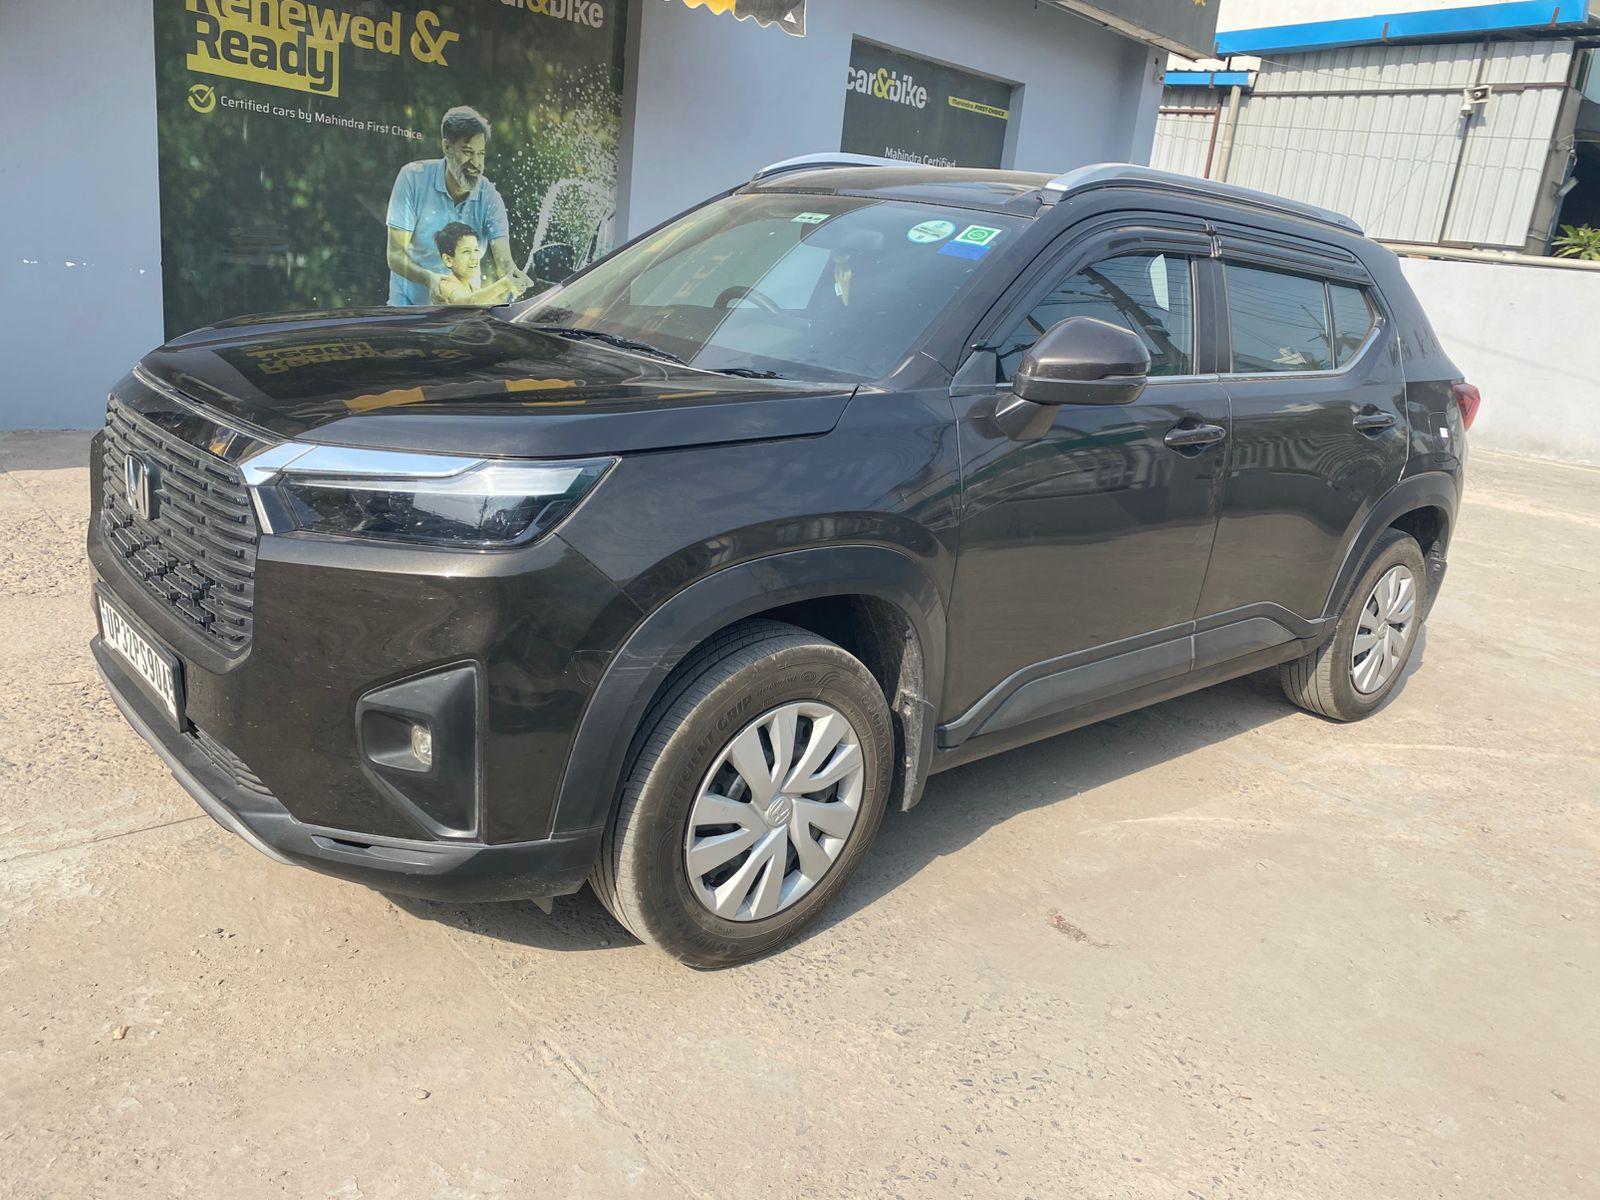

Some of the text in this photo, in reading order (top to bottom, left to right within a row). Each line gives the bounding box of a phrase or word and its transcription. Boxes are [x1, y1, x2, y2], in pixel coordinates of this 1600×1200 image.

[491, 0, 604, 28] bike
[194, 13, 334, 92] Ready
[410, 10, 460, 67] &
[846, 66, 928, 109] car&bike
[220, 95, 422, 140] Certified cars by Mahindra First Choice
[884, 146, 957, 168] Mahindra Certified
